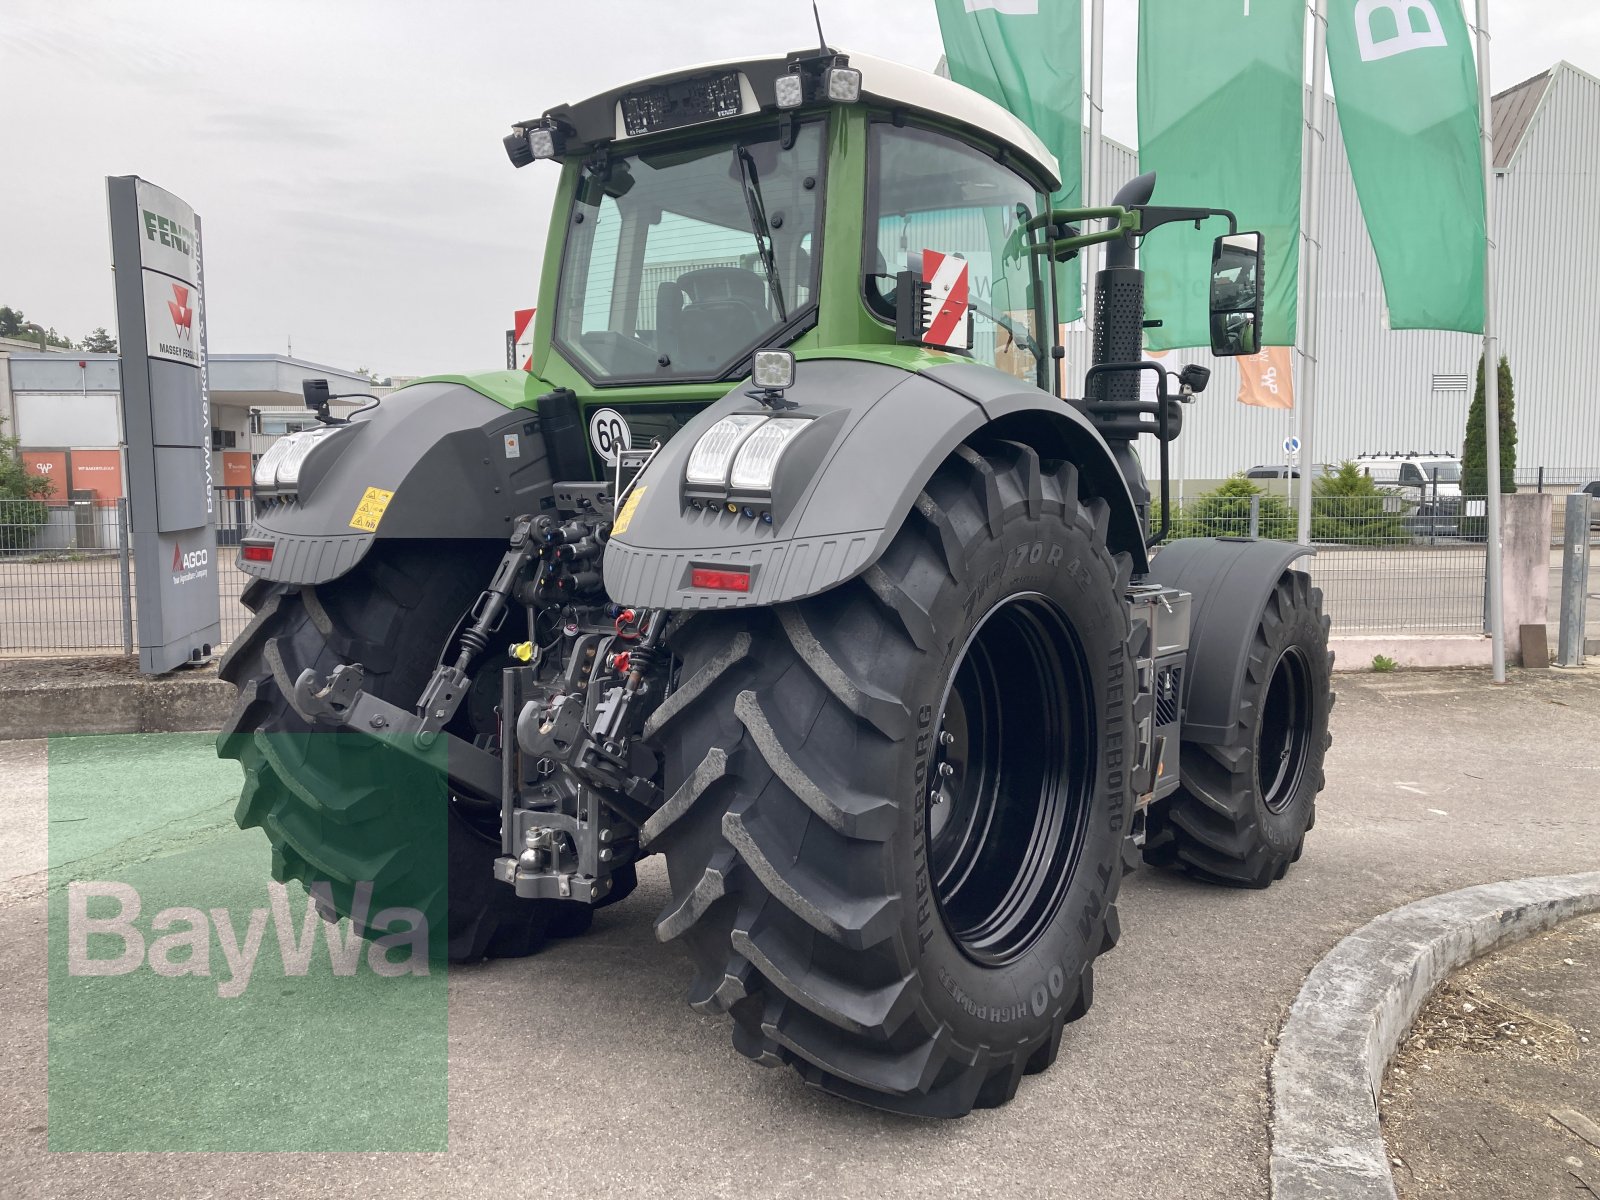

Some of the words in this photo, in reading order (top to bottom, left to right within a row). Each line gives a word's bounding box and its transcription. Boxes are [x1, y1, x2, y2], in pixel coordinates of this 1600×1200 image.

[142, 208, 195, 259] FENDT
[159, 342, 182, 357] MASSEY
[596, 418, 625, 453] 60
[183, 549, 208, 570] AGCO
